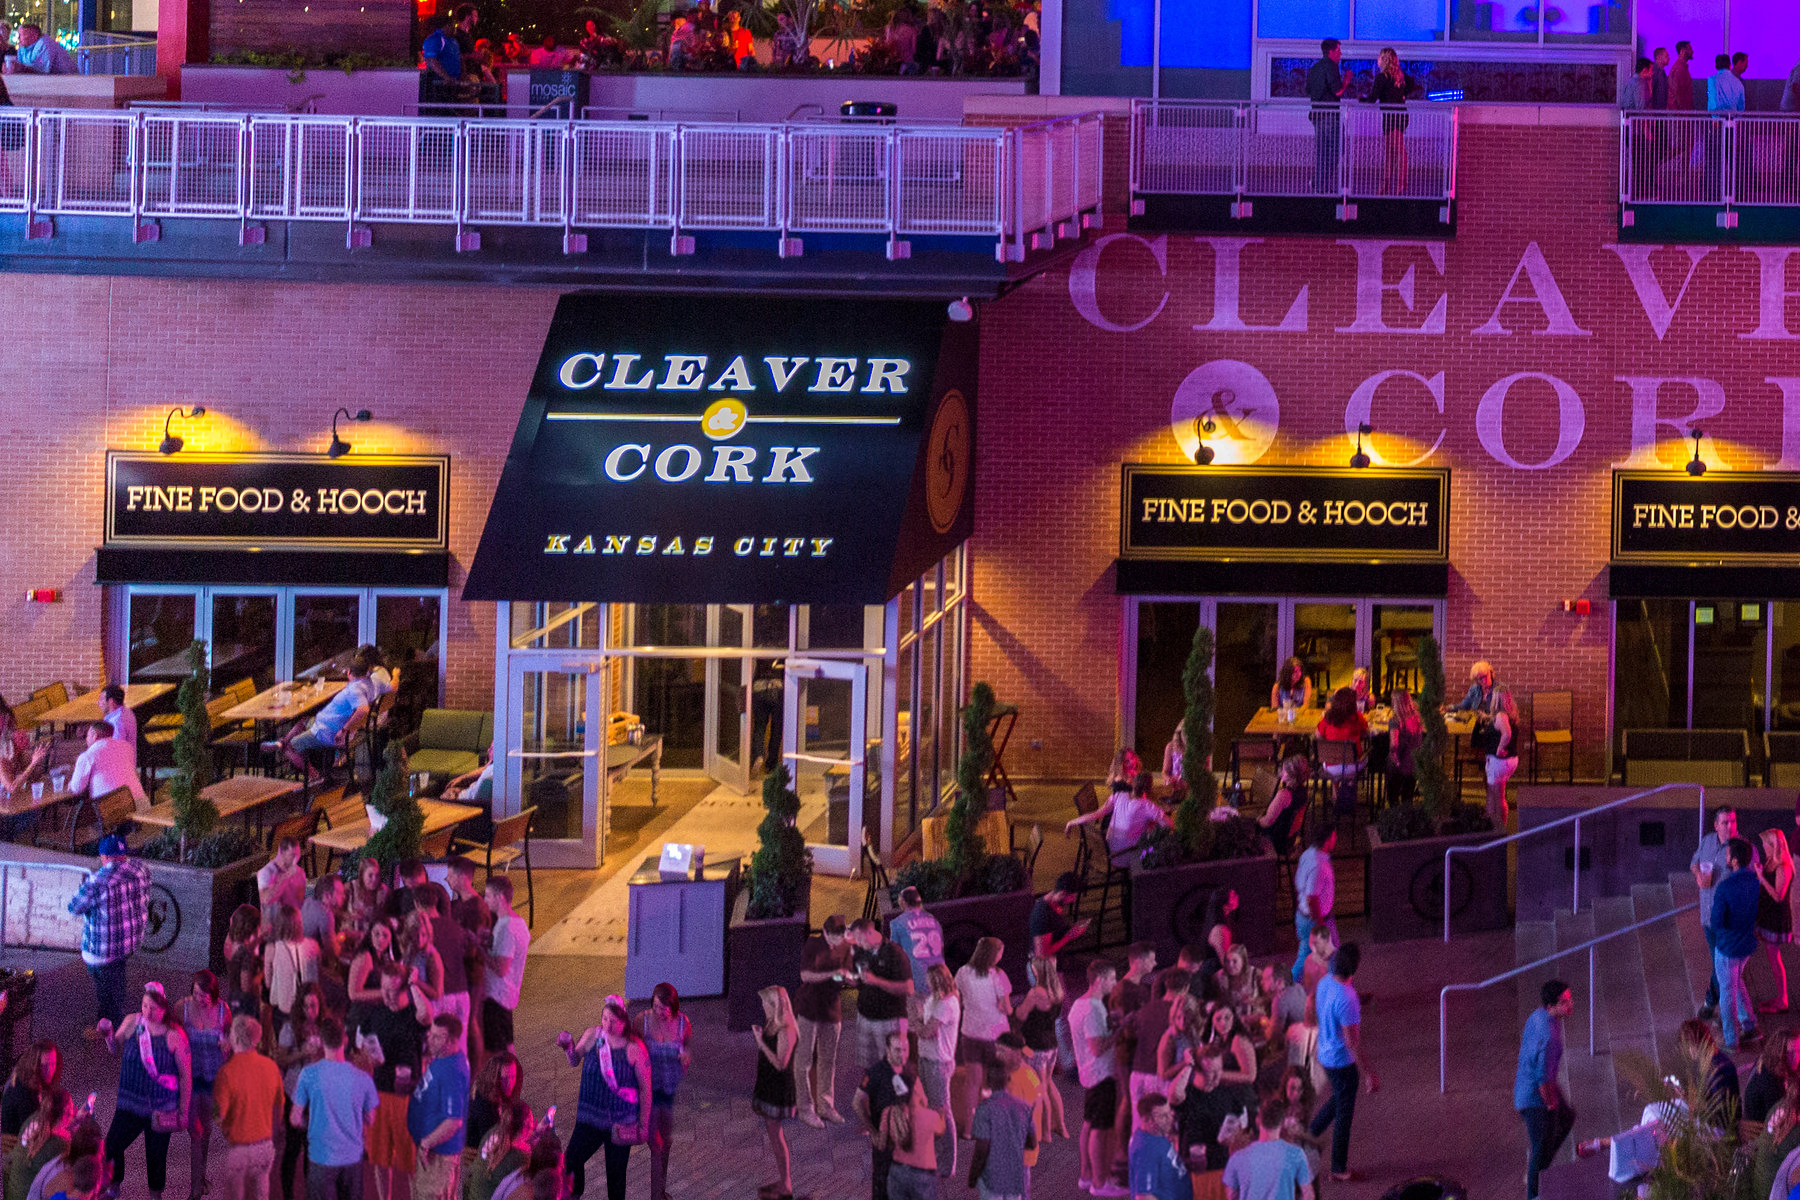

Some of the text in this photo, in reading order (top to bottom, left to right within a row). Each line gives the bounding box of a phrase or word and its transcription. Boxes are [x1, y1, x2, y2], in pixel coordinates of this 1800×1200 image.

[531, 83, 576, 97] mosaic
[558, 352, 912, 394] CLEAVER
[708, 406, 739, 431] &
[604, 442, 821, 483] CORK
[126, 486, 427, 515] FINE FOOD & HOOCH
[1142, 498, 1429, 526] FINE FOOD & HOOCH
[1632, 503, 1695, 529] FINE
[1700, 504, 1780, 529] FOOD
[543, 534, 833, 557] KANSAS CITY
[909, 930, 939, 958] 29
